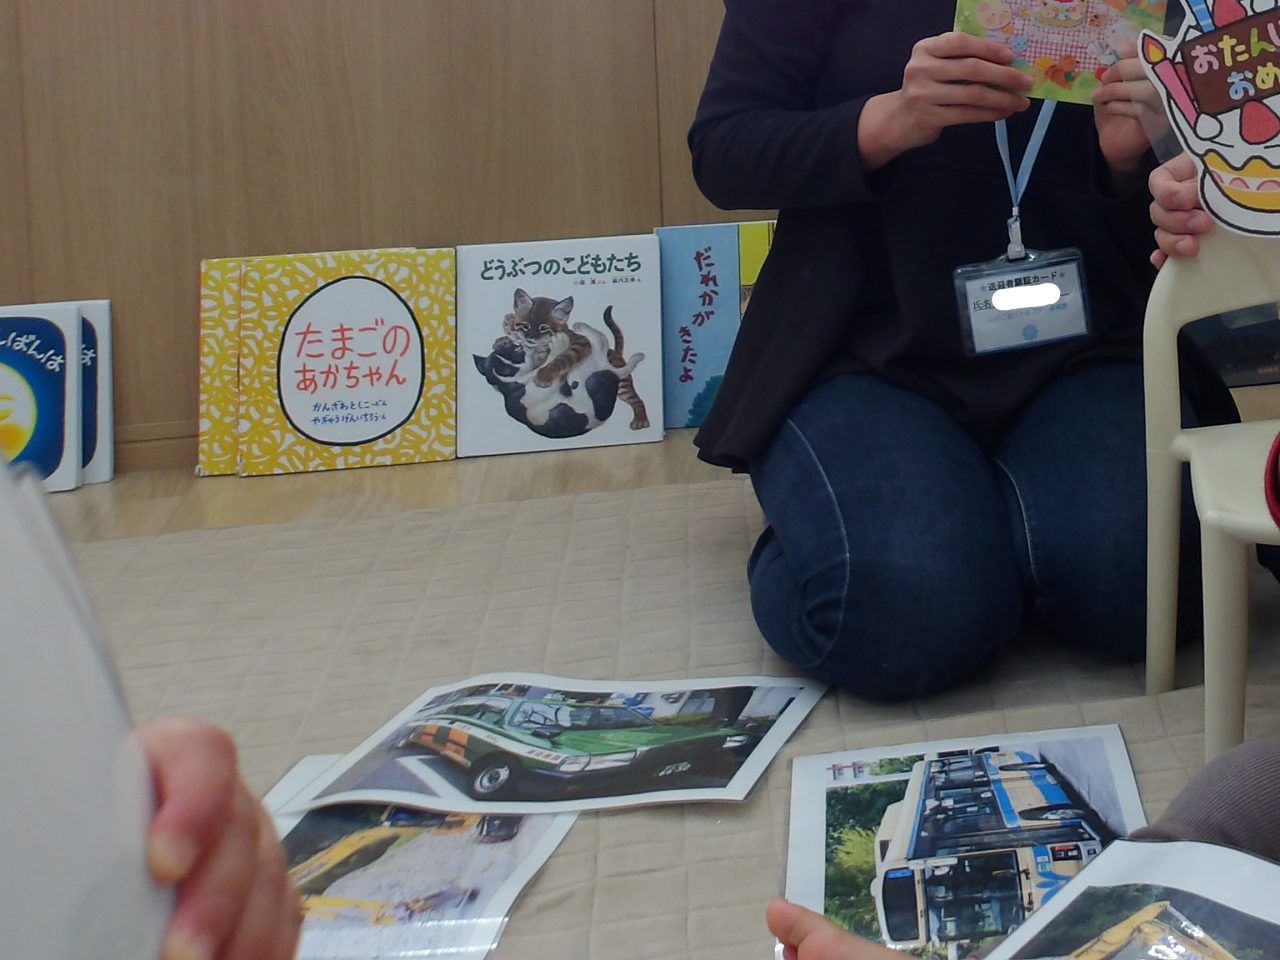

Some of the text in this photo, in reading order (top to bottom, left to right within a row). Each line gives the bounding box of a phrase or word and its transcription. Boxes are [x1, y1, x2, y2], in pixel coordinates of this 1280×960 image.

[480, 252, 642, 280] どうぶつのこどもたち
[692, 246, 719, 327] だれかが
[0, 332, 65, 372] ばんは
[295, 318, 411, 359] たまごの
[678, 326, 698, 383] きたよ
[294, 359, 406, 395] あかちゃん
